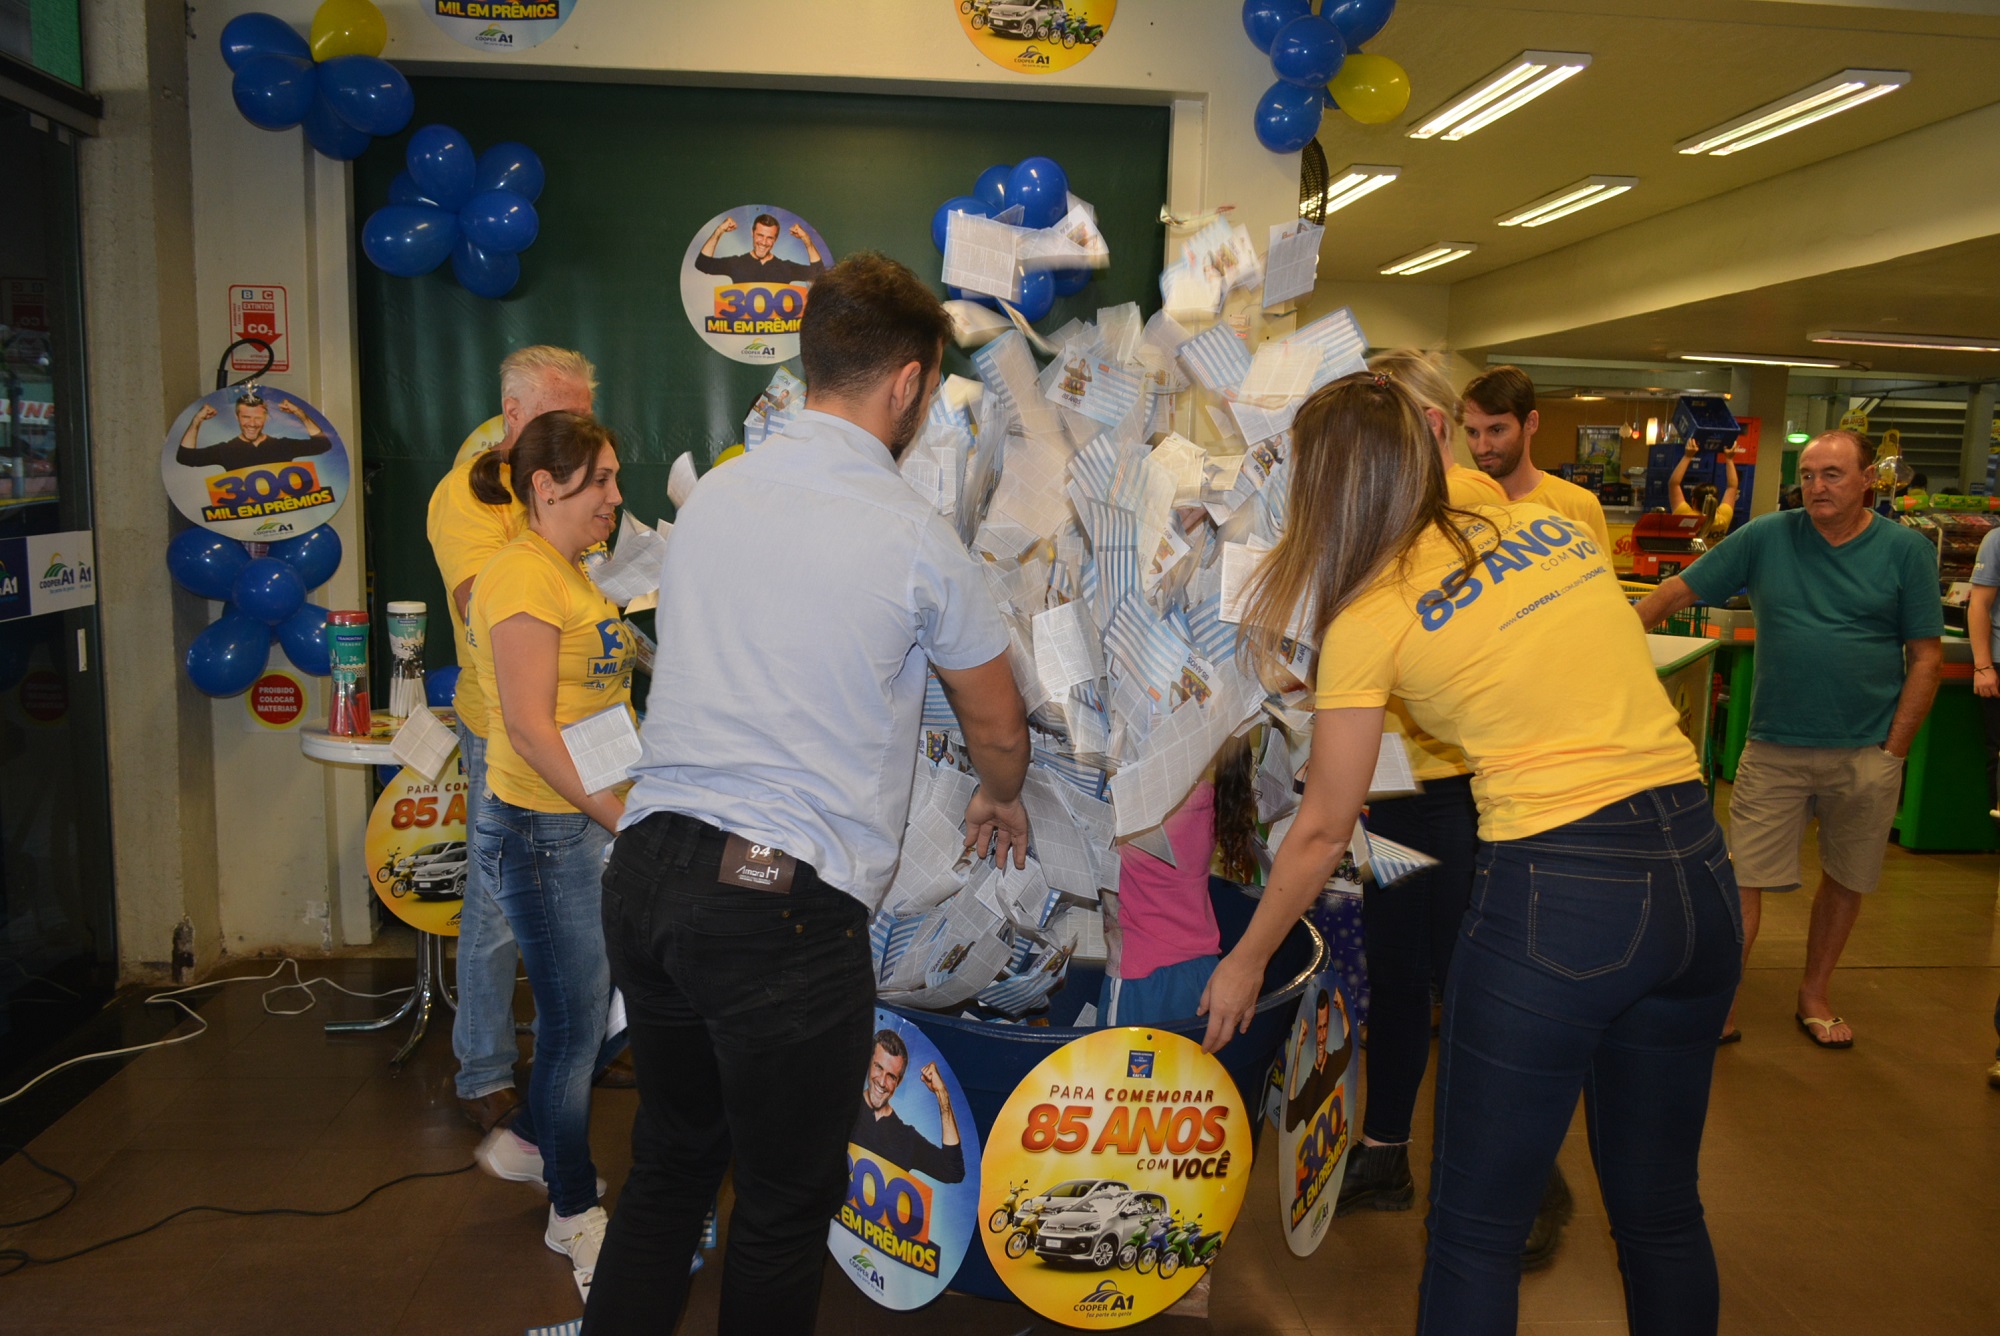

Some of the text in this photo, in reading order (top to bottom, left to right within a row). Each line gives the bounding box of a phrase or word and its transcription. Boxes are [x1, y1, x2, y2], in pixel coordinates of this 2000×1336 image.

[438, 1, 557, 18] MIL EM PRÊMIOS
[498, 34, 513, 43] A1
[1035, 56, 1050, 65] A1
[243, 290, 273, 299] B C
[719, 287, 803, 320] 300
[708, 319, 732, 332] MIL
[734, 321, 753, 333] EM
[762, 347, 775, 356] A1
[214, 466, 313, 508] 300
[206, 489, 332, 521] MIL EM PRÊMIOS
[278, 523, 293, 532] A1
[1540, 551, 1571, 572] COM
[39, 567, 75, 590] COOPER A1
[80, 566, 92, 583] A1
[3, 575, 18, 595] A1
[593, 661, 618, 675] MIL
[258, 686, 295, 694] PROIBIDO
[407, 784, 438, 795] PARA
[391, 797, 438, 831] 85
[751, 844, 771, 858] 94
[1050, 1085, 1215, 1103] PARA COMEMORAR
[1021, 1103, 1229, 1155] 85 ANOS
[1297, 1095, 1342, 1193] 300
[1136, 1150, 1231, 1180] COM VOCÊ
[1292, 1126, 1348, 1227] MIL EM PRÊMIOS
[841, 1205, 937, 1273] EM PRÊMIOS
[849, 1258, 885, 1291] COOPER A1
[1073, 1295, 1135, 1311] COOPER A1
